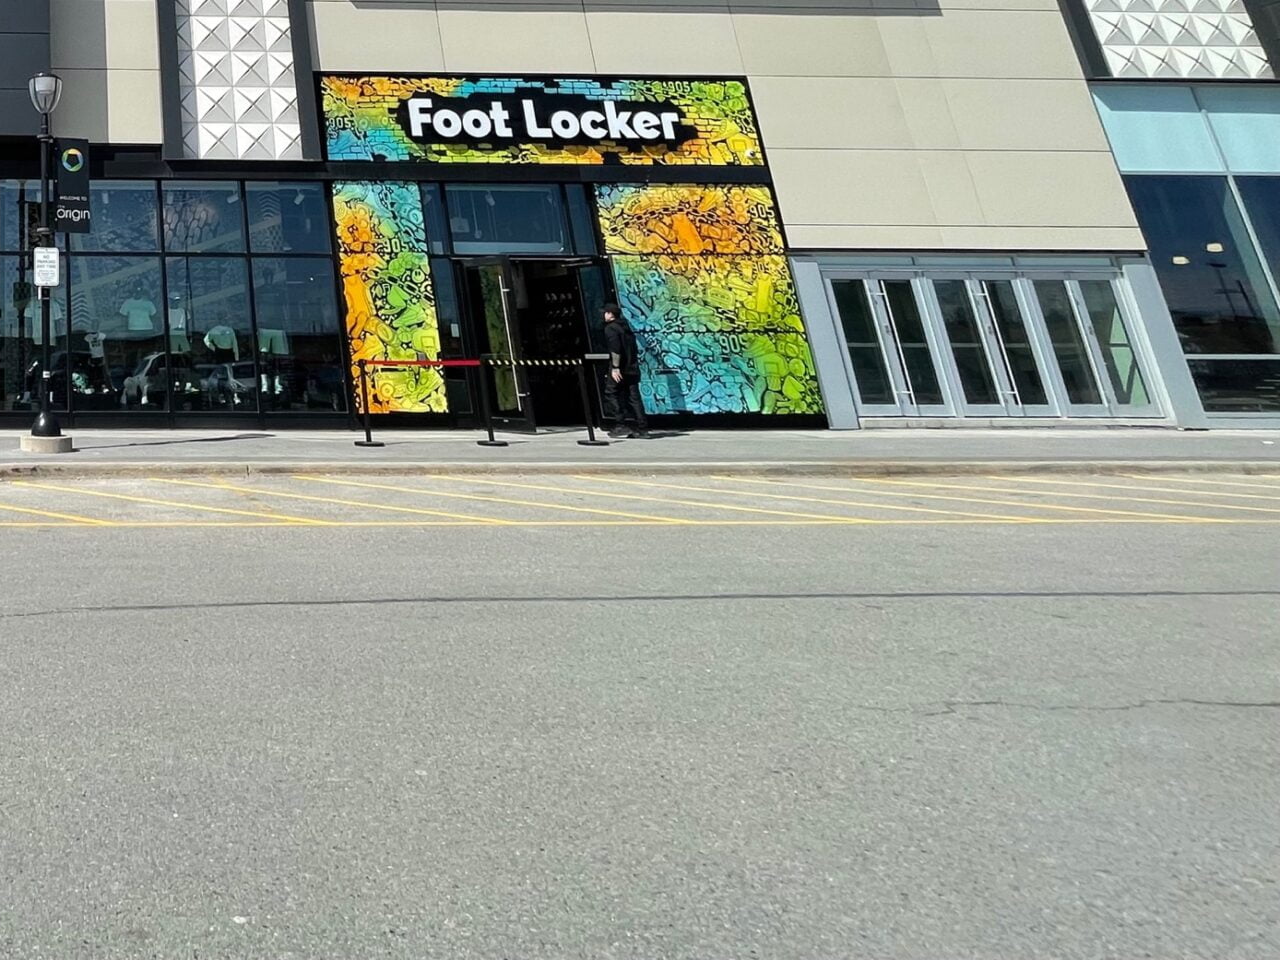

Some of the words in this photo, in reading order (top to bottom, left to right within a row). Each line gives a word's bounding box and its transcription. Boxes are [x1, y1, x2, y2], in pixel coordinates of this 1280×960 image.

[667, 81, 691, 93] 905
[328, 117, 351, 129] 905
[407, 97, 514, 139] Foot
[521, 98, 680, 141] Locker
[56, 208, 90, 222] Origin
[750, 205, 775, 218] 905
